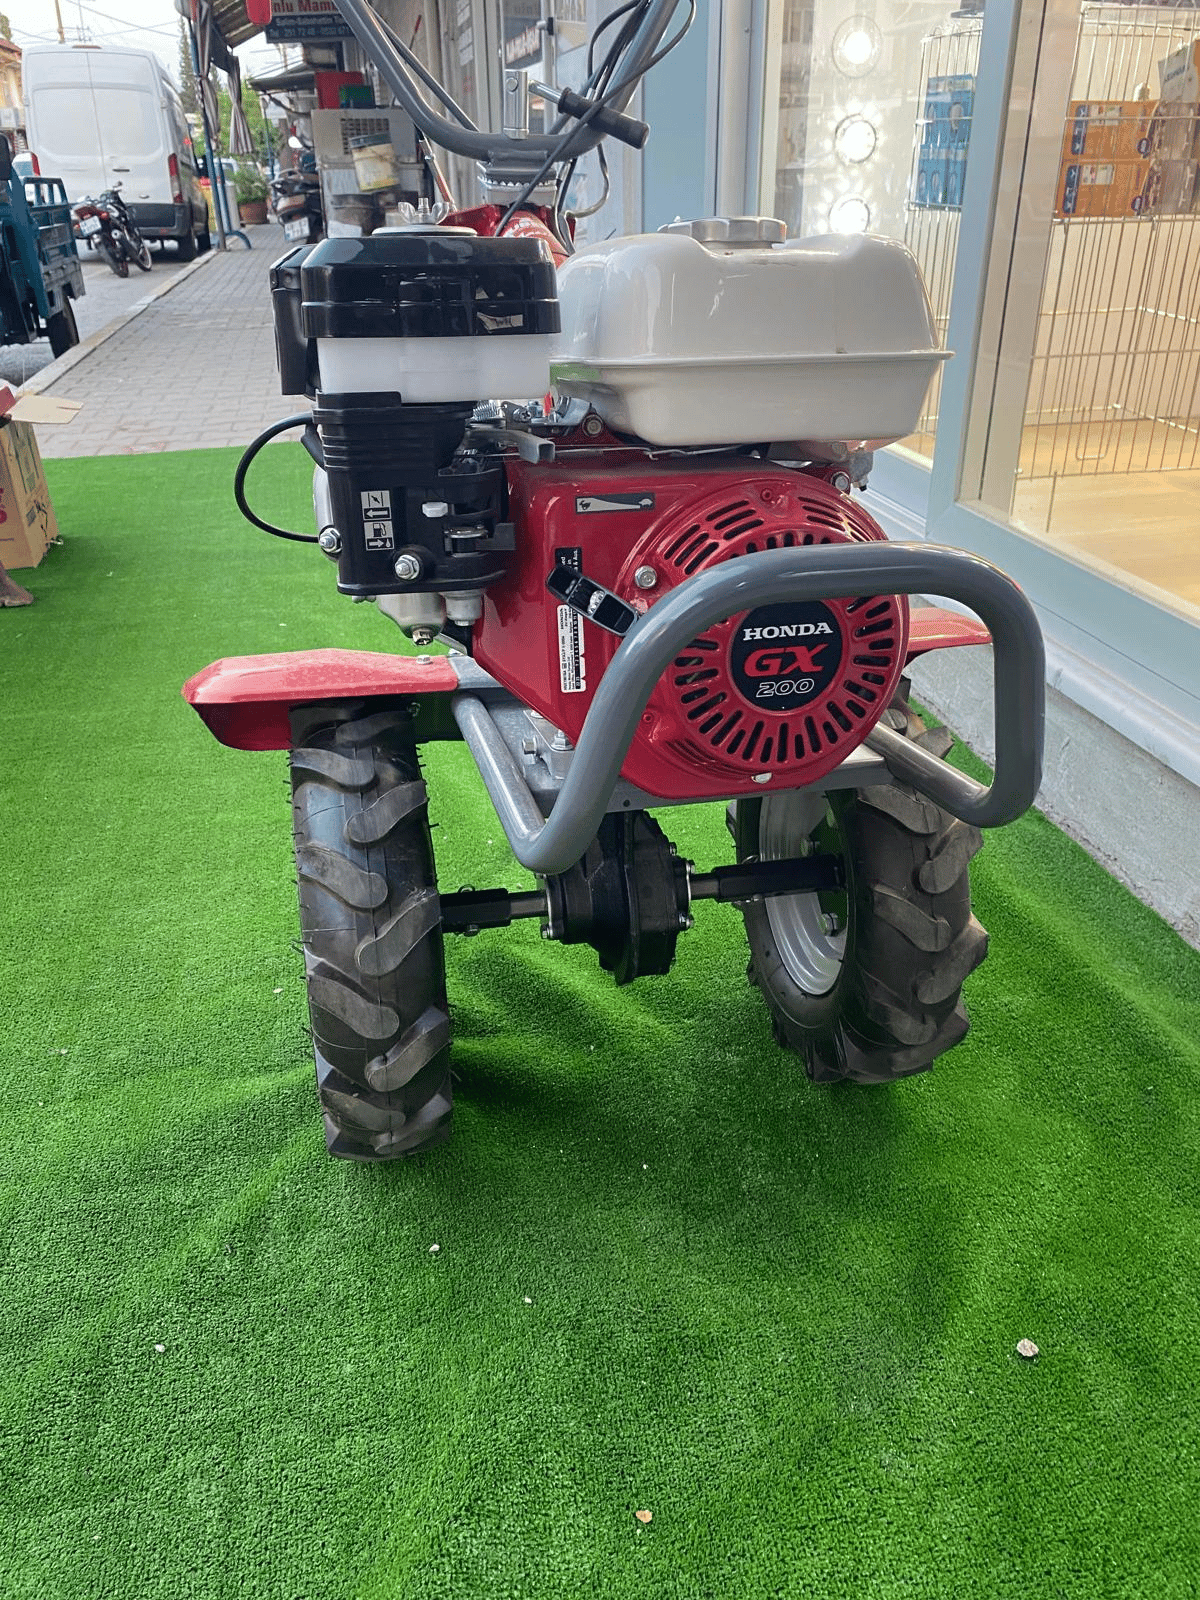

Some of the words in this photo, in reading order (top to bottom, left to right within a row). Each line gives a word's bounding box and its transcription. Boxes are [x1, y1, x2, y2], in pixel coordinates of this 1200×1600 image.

[743, 622, 834, 641] HONDA
[744, 643, 829, 677] GX
[756, 678, 815, 698] 200
